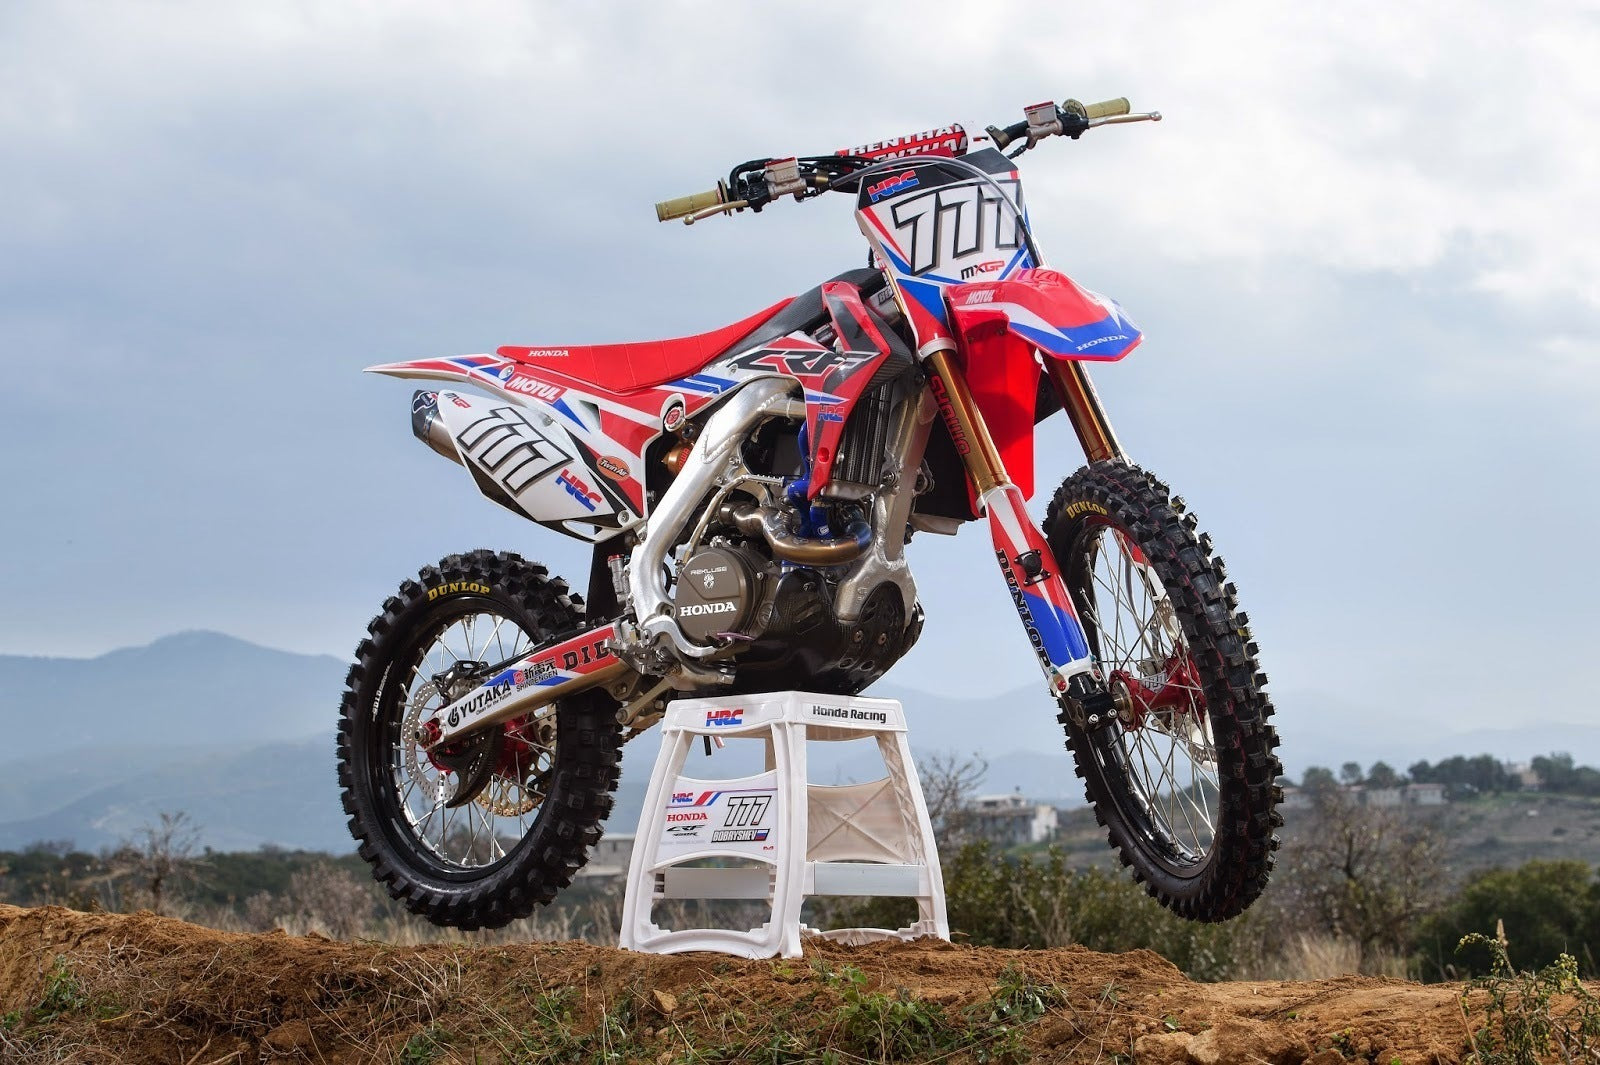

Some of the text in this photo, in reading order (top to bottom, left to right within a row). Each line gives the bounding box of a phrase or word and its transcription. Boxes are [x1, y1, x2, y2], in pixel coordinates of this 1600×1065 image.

[867, 170, 919, 201] HRC
[890, 178, 1020, 277] 777
[960, 260, 1005, 280] MXGP
[965, 289, 996, 305] MOTUL
[1076, 333, 1128, 352] HONDA
[507, 374, 560, 401] MOTUL
[817, 403, 845, 422] HRC
[456, 406, 575, 498] 777
[554, 468, 602, 512] HRC
[1065, 499, 1108, 518] DUNLOP
[427, 581, 491, 601] DUNLOP
[680, 602, 736, 617] HONDA
[460, 680, 511, 718] YUTAKA
[705, 709, 744, 727] HRC
[812, 705, 887, 724] Honda Racing
[672, 792, 694, 803] HRC
[667, 812, 708, 822] HONDA
[723, 795, 772, 827] 777
